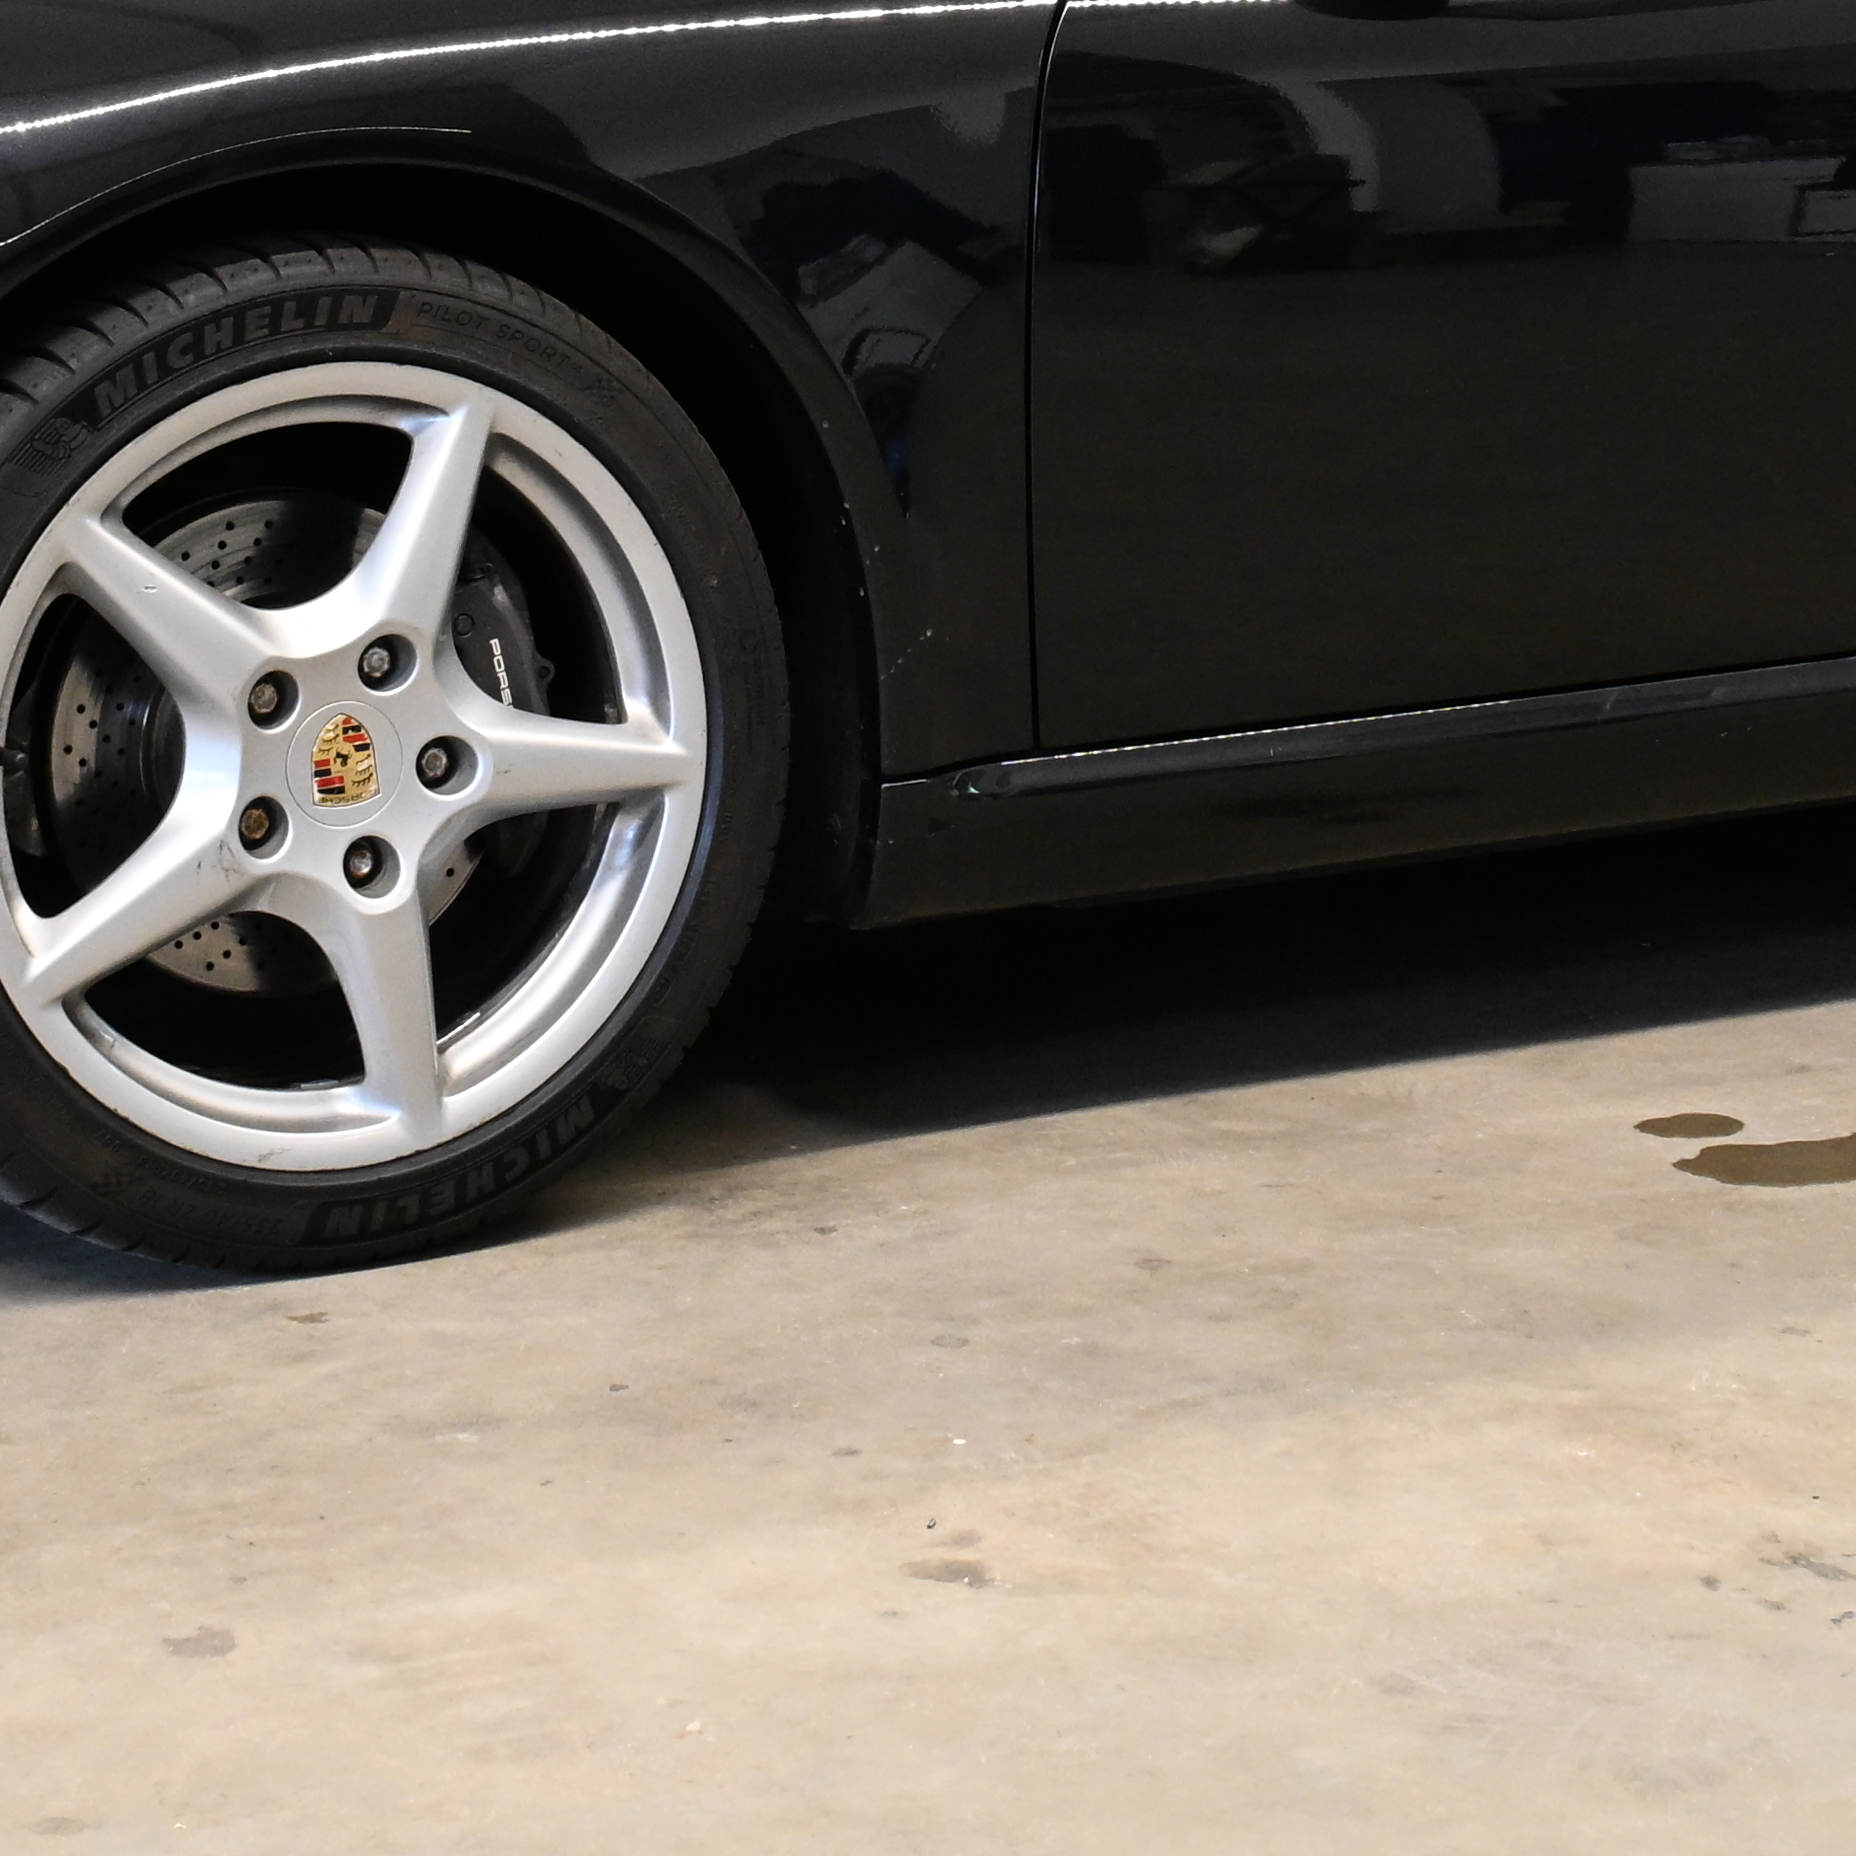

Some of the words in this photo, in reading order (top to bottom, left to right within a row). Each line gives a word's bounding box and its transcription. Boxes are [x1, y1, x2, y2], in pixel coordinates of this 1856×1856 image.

[94, 293, 378, 418] MICHELIN
[416, 301, 490, 331] PILOT
[495, 323, 572, 369] SPORT
[488, 637, 514, 707] PORS
[323, 1094, 594, 1237] MICHELIN
